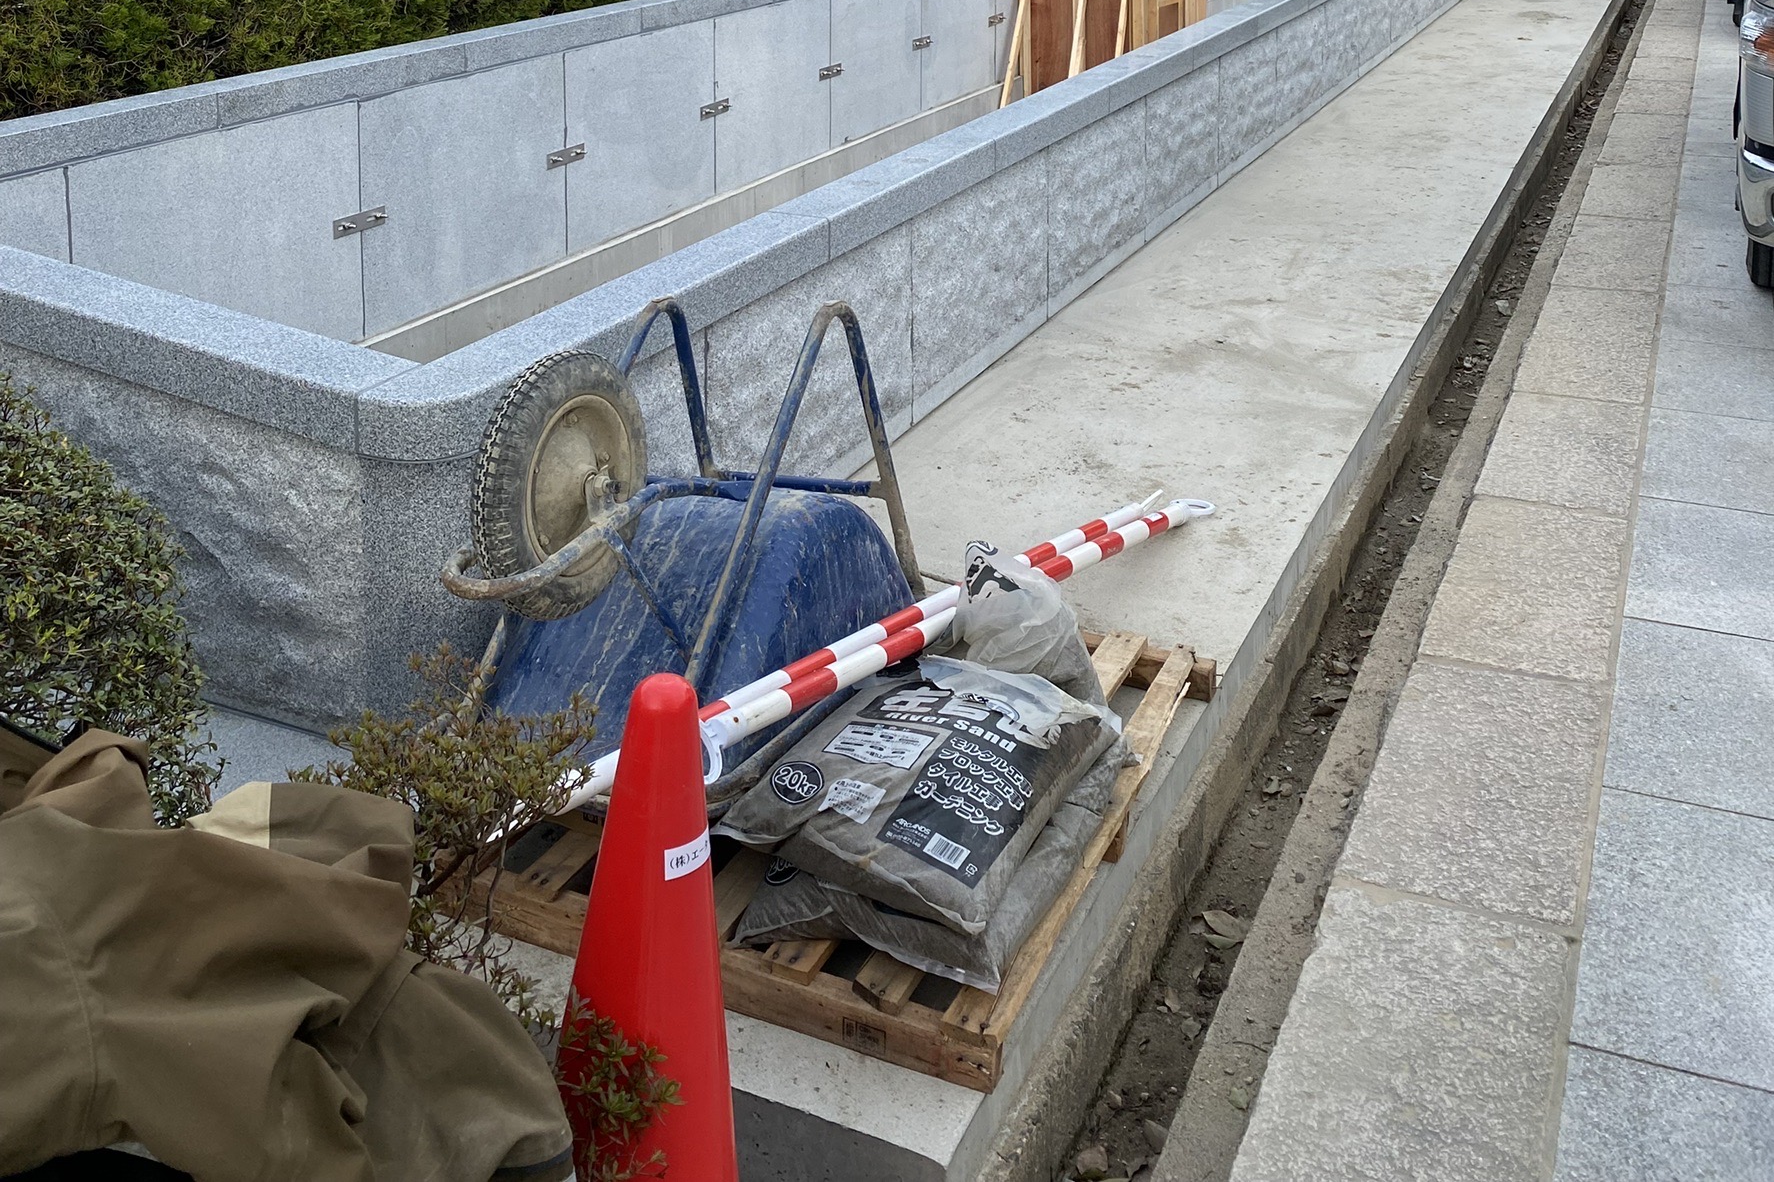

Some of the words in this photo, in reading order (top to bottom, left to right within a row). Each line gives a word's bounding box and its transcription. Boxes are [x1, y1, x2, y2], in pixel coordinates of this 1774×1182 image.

[774, 766, 818, 798] 20kg
[927, 762, 1003, 811] タイル工事
[938, 748, 1025, 811] ブロック工事
[950, 737, 1034, 797] モルタル工事
[914, 780, 1005, 835] ガーデニング
